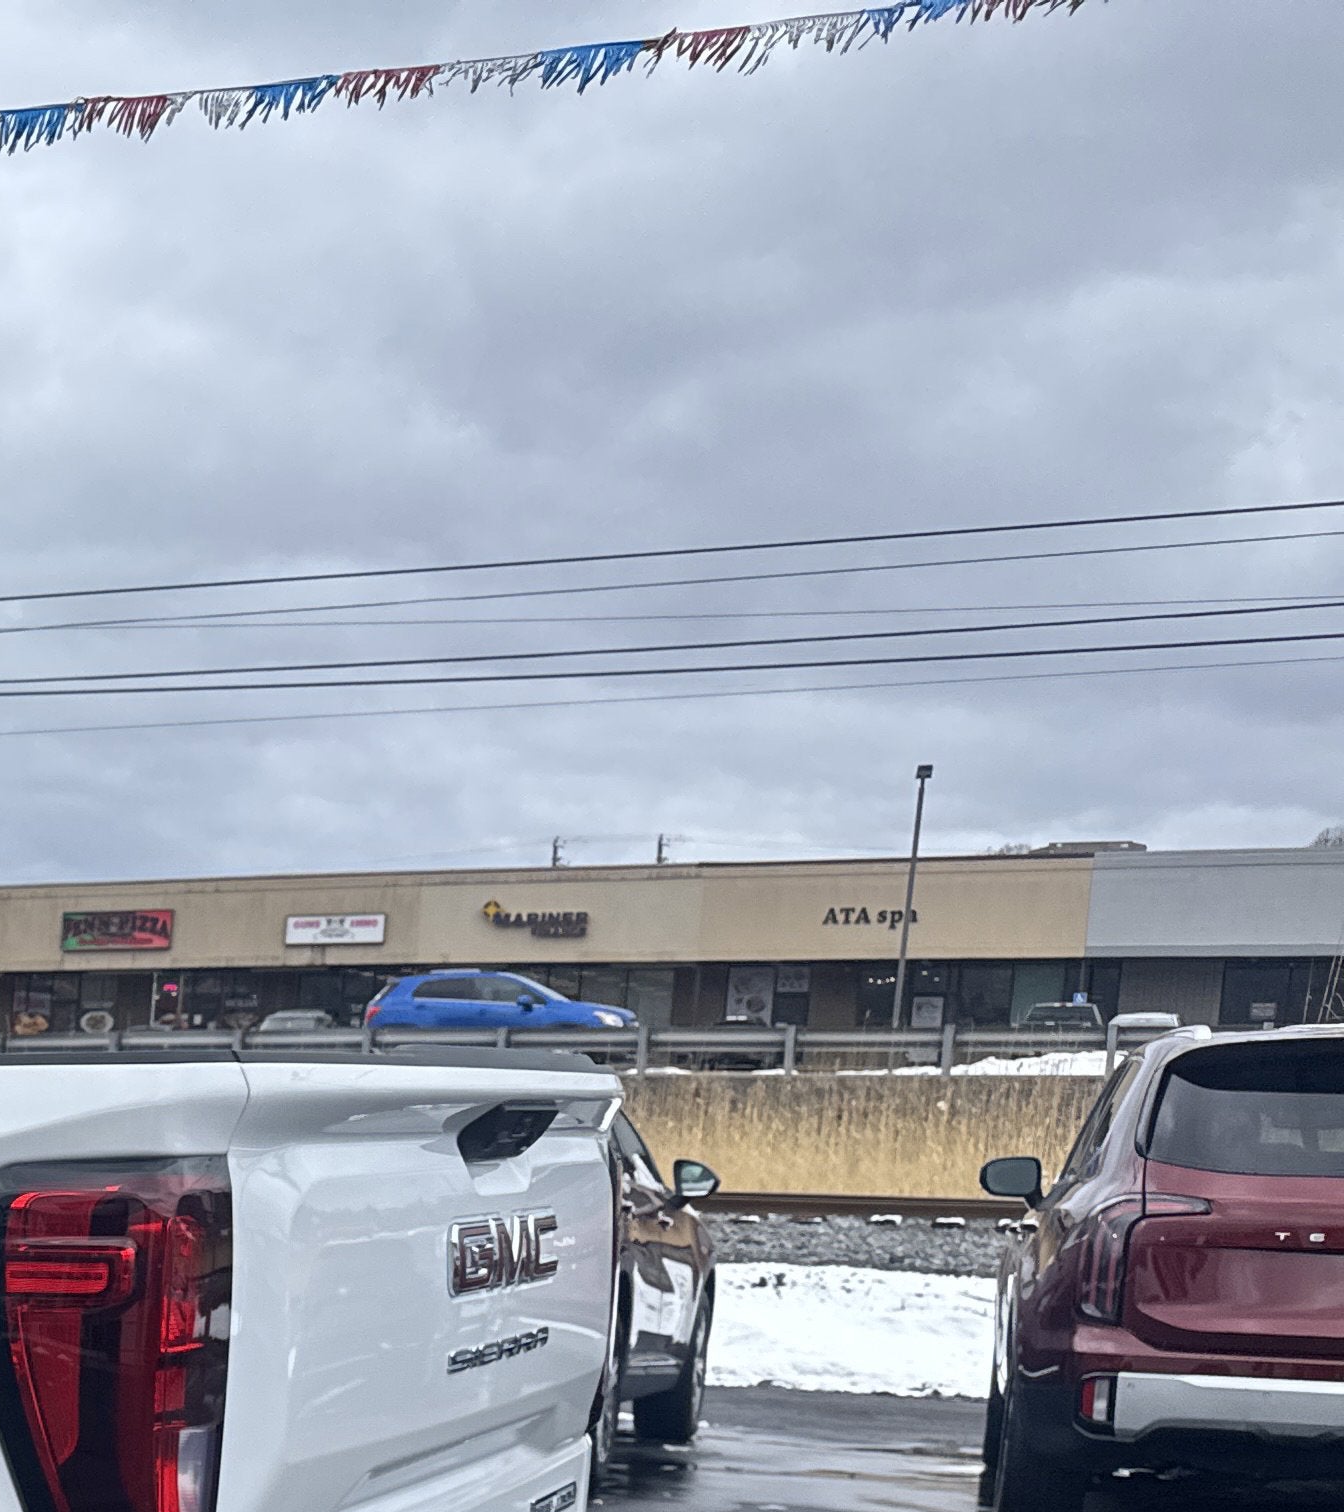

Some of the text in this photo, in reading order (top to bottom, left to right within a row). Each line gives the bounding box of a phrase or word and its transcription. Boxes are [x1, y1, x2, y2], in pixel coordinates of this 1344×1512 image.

[821, 906, 872, 925] ATA
[446, 1206, 559, 1299] GMC
[446, 1326, 550, 1376] SIERRA
